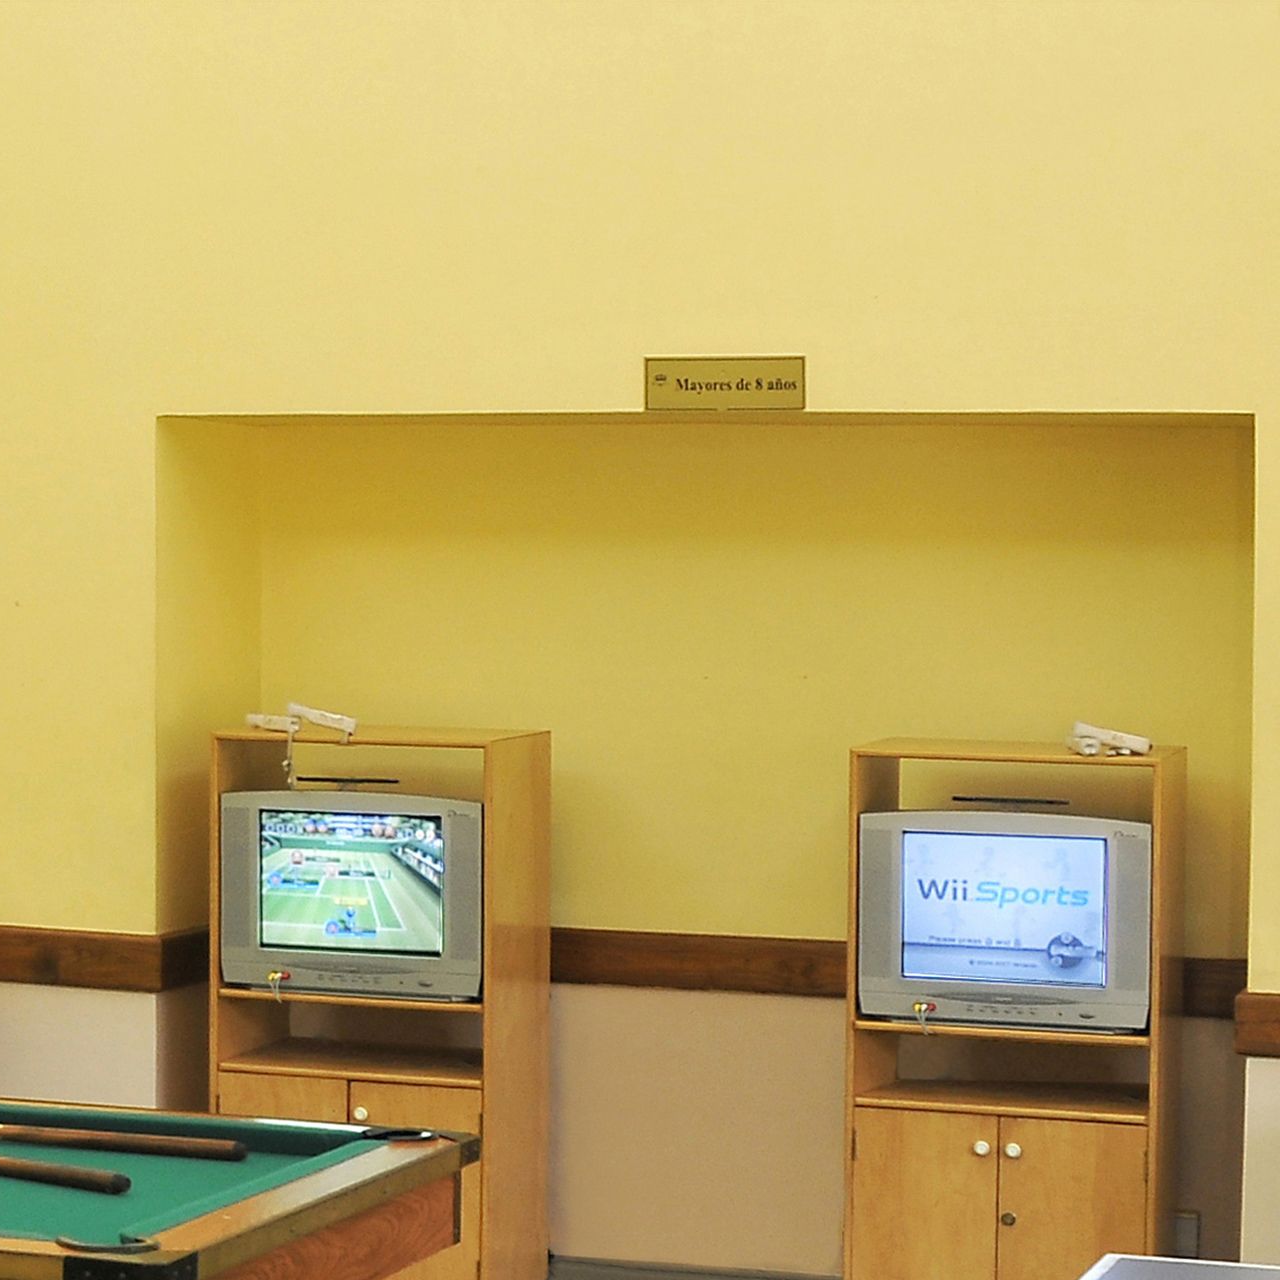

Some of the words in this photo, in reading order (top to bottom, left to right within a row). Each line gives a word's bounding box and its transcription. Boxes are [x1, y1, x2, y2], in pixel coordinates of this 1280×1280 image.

[675, 378, 732, 394] Mayores
[736, 378, 751, 391] de
[755, 378, 763, 391] 8
[767, 378, 797, 391] años
[917, 879, 968, 902] Wii
[975, 881, 1089, 908] Sports
